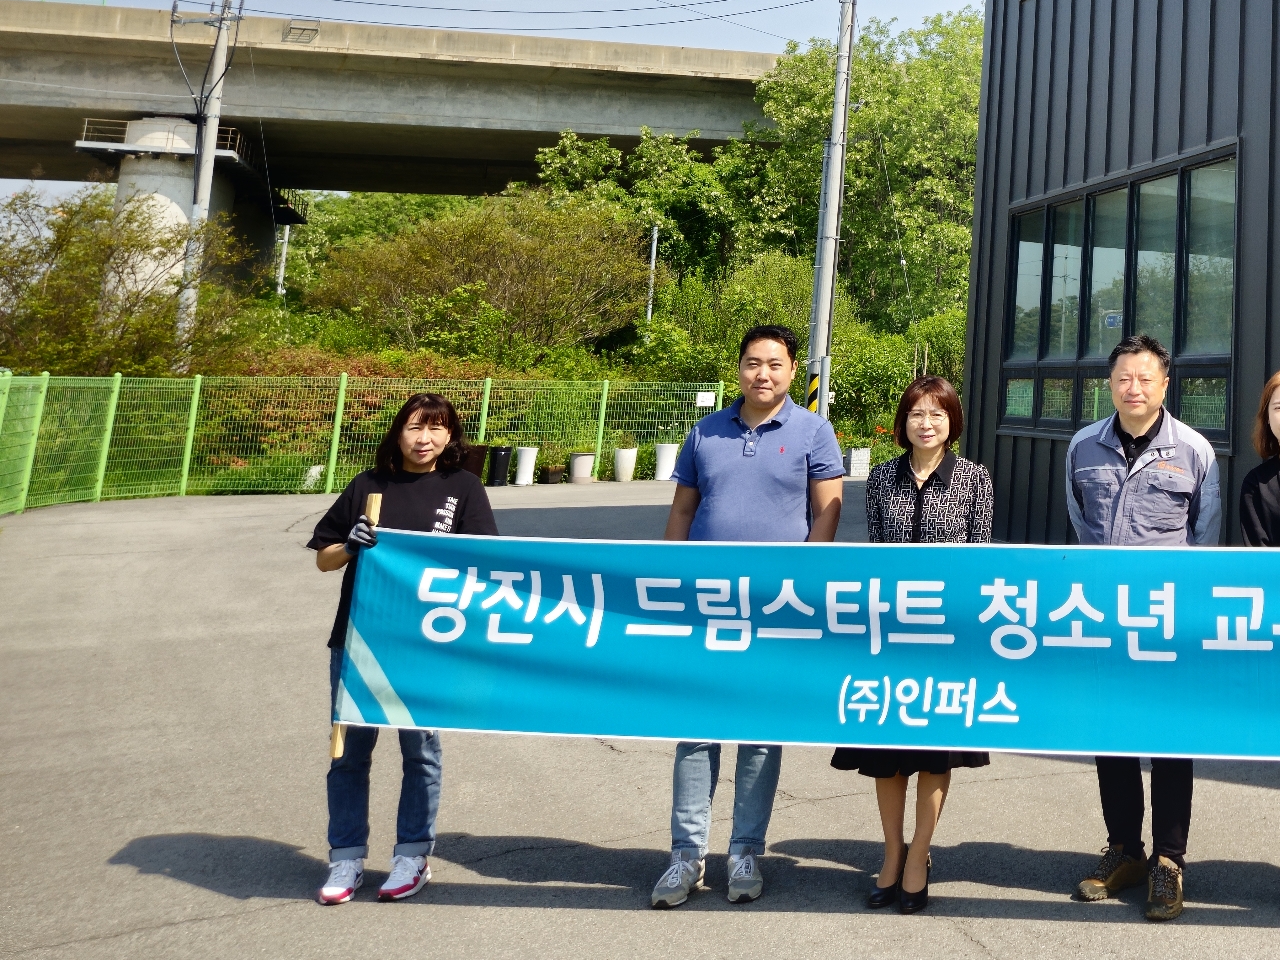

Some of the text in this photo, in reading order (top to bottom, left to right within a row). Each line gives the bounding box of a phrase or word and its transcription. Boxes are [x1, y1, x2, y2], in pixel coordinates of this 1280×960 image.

[417, 566, 603, 648] 당진시
[625, 576, 955, 655] 드림스타트
[978, 578, 1178, 661] 청소년
[838, 674, 1020, 727] (주)인퍼스
